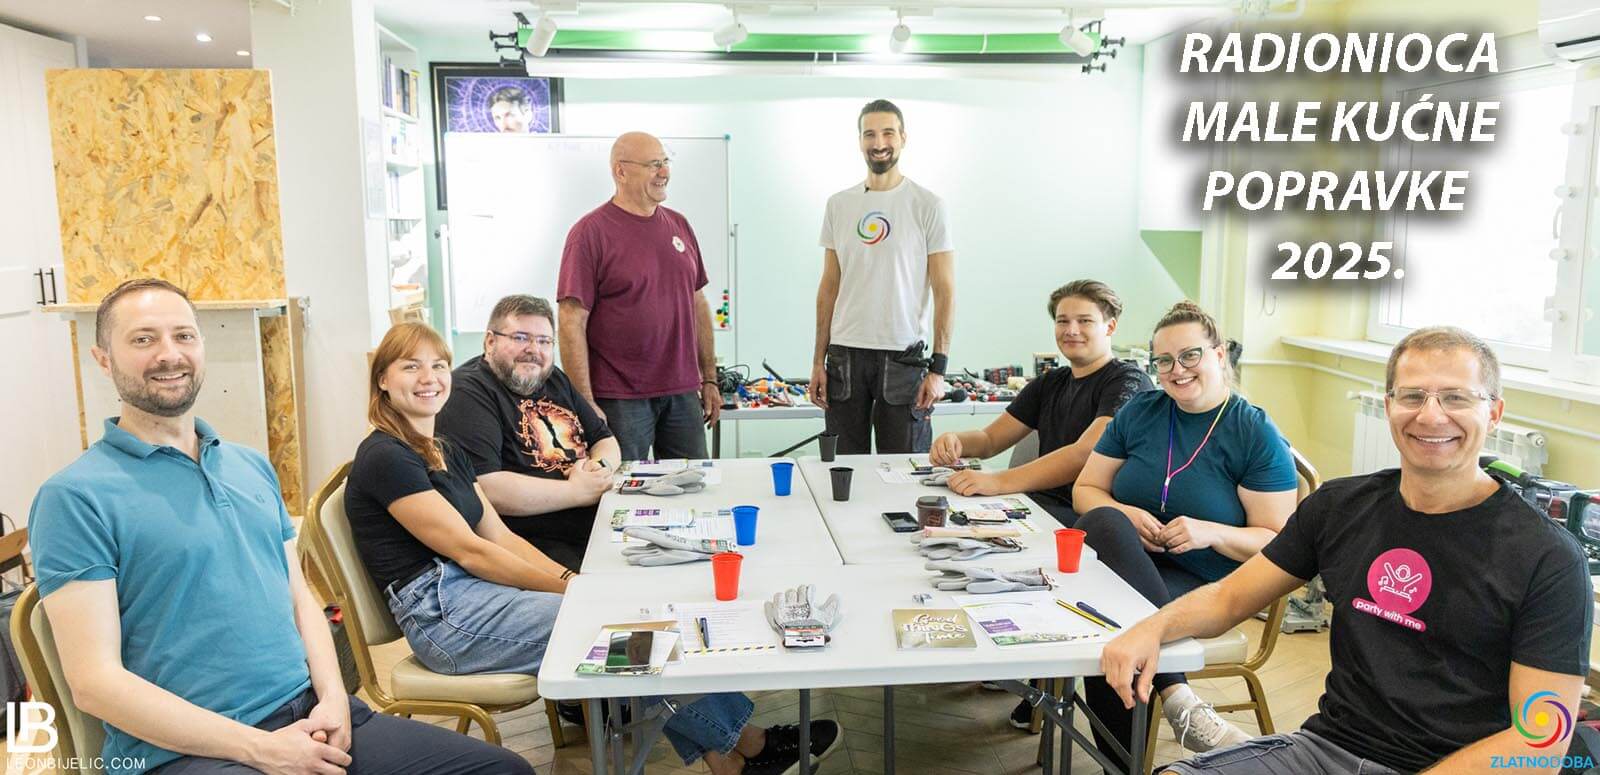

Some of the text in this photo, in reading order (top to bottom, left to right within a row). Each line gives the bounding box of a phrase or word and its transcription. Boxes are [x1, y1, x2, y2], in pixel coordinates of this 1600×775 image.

[1356, 601, 1421, 631] party with me
